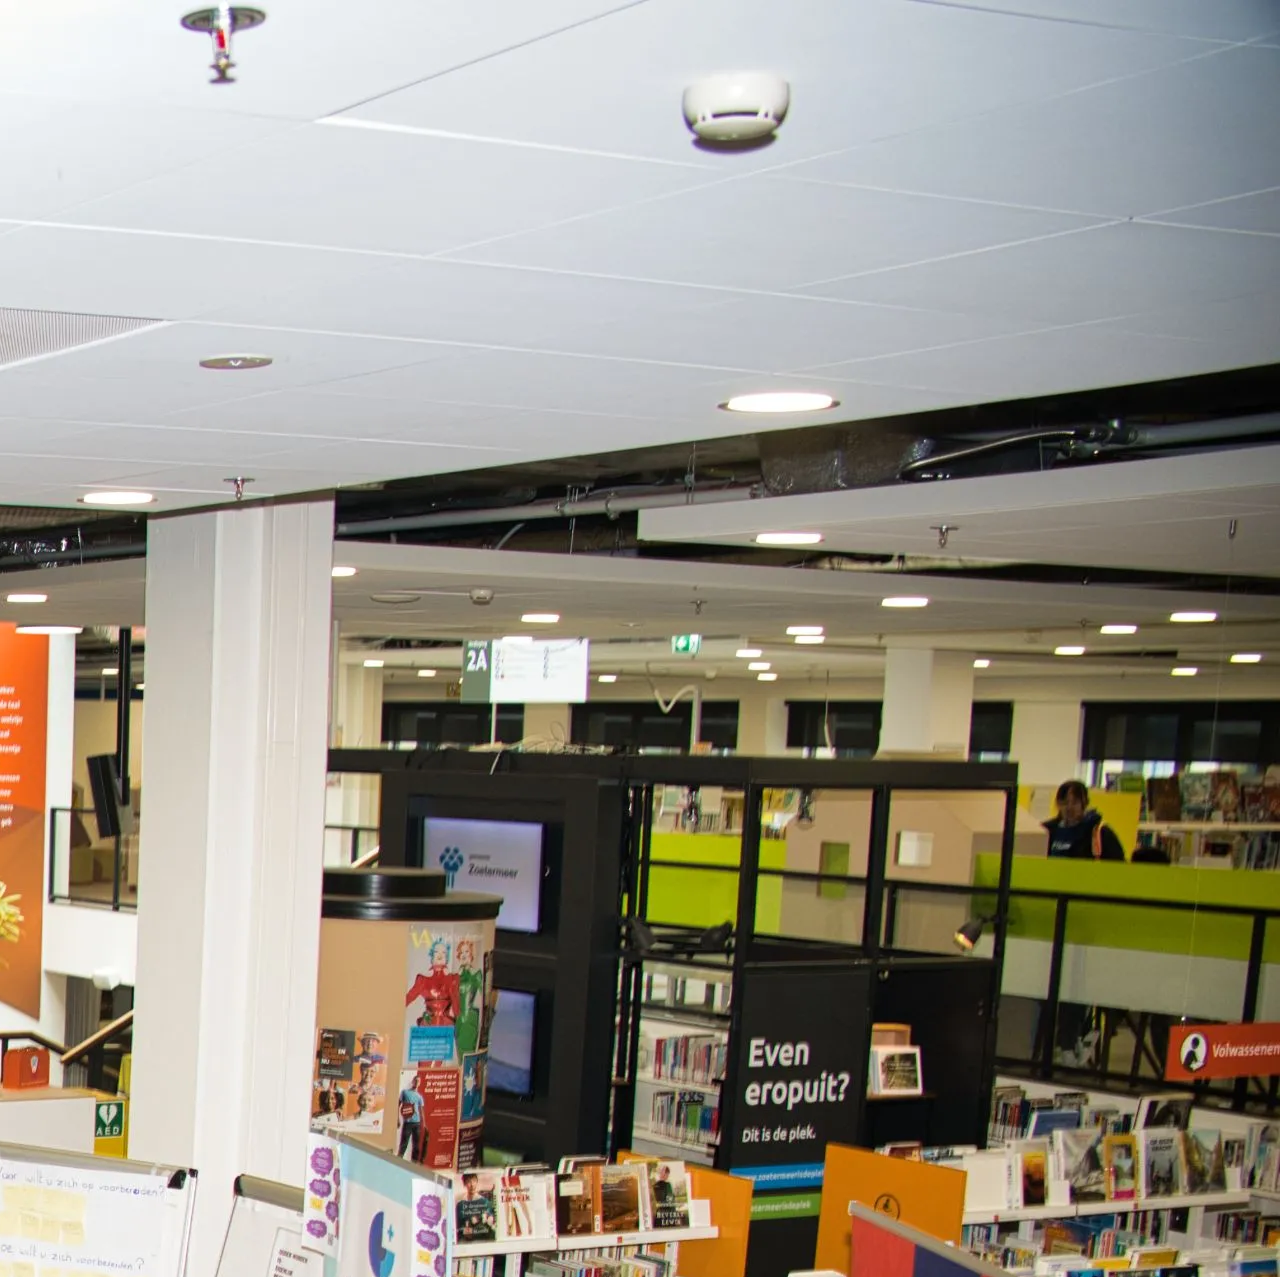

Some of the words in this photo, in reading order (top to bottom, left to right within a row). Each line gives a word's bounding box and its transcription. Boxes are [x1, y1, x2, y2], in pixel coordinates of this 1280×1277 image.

[467, 648, 487, 672] 2A
[468, 863, 519, 880] Zoetermeer
[748, 1037, 810, 1068] Even
[745, 1071, 850, 1111] eropuit?
[96, 1126, 120, 1136] AED
[742, 1127, 760, 1143] Dit
[761, 1125, 771, 1142] is
[773, 1124, 787, 1141] de
[789, 1123, 816, 1143] plek.
[56, 1176, 78, 1189] zich
[82, 1183, 95, 1193] op
[51, 1251, 72, 1263] zich
